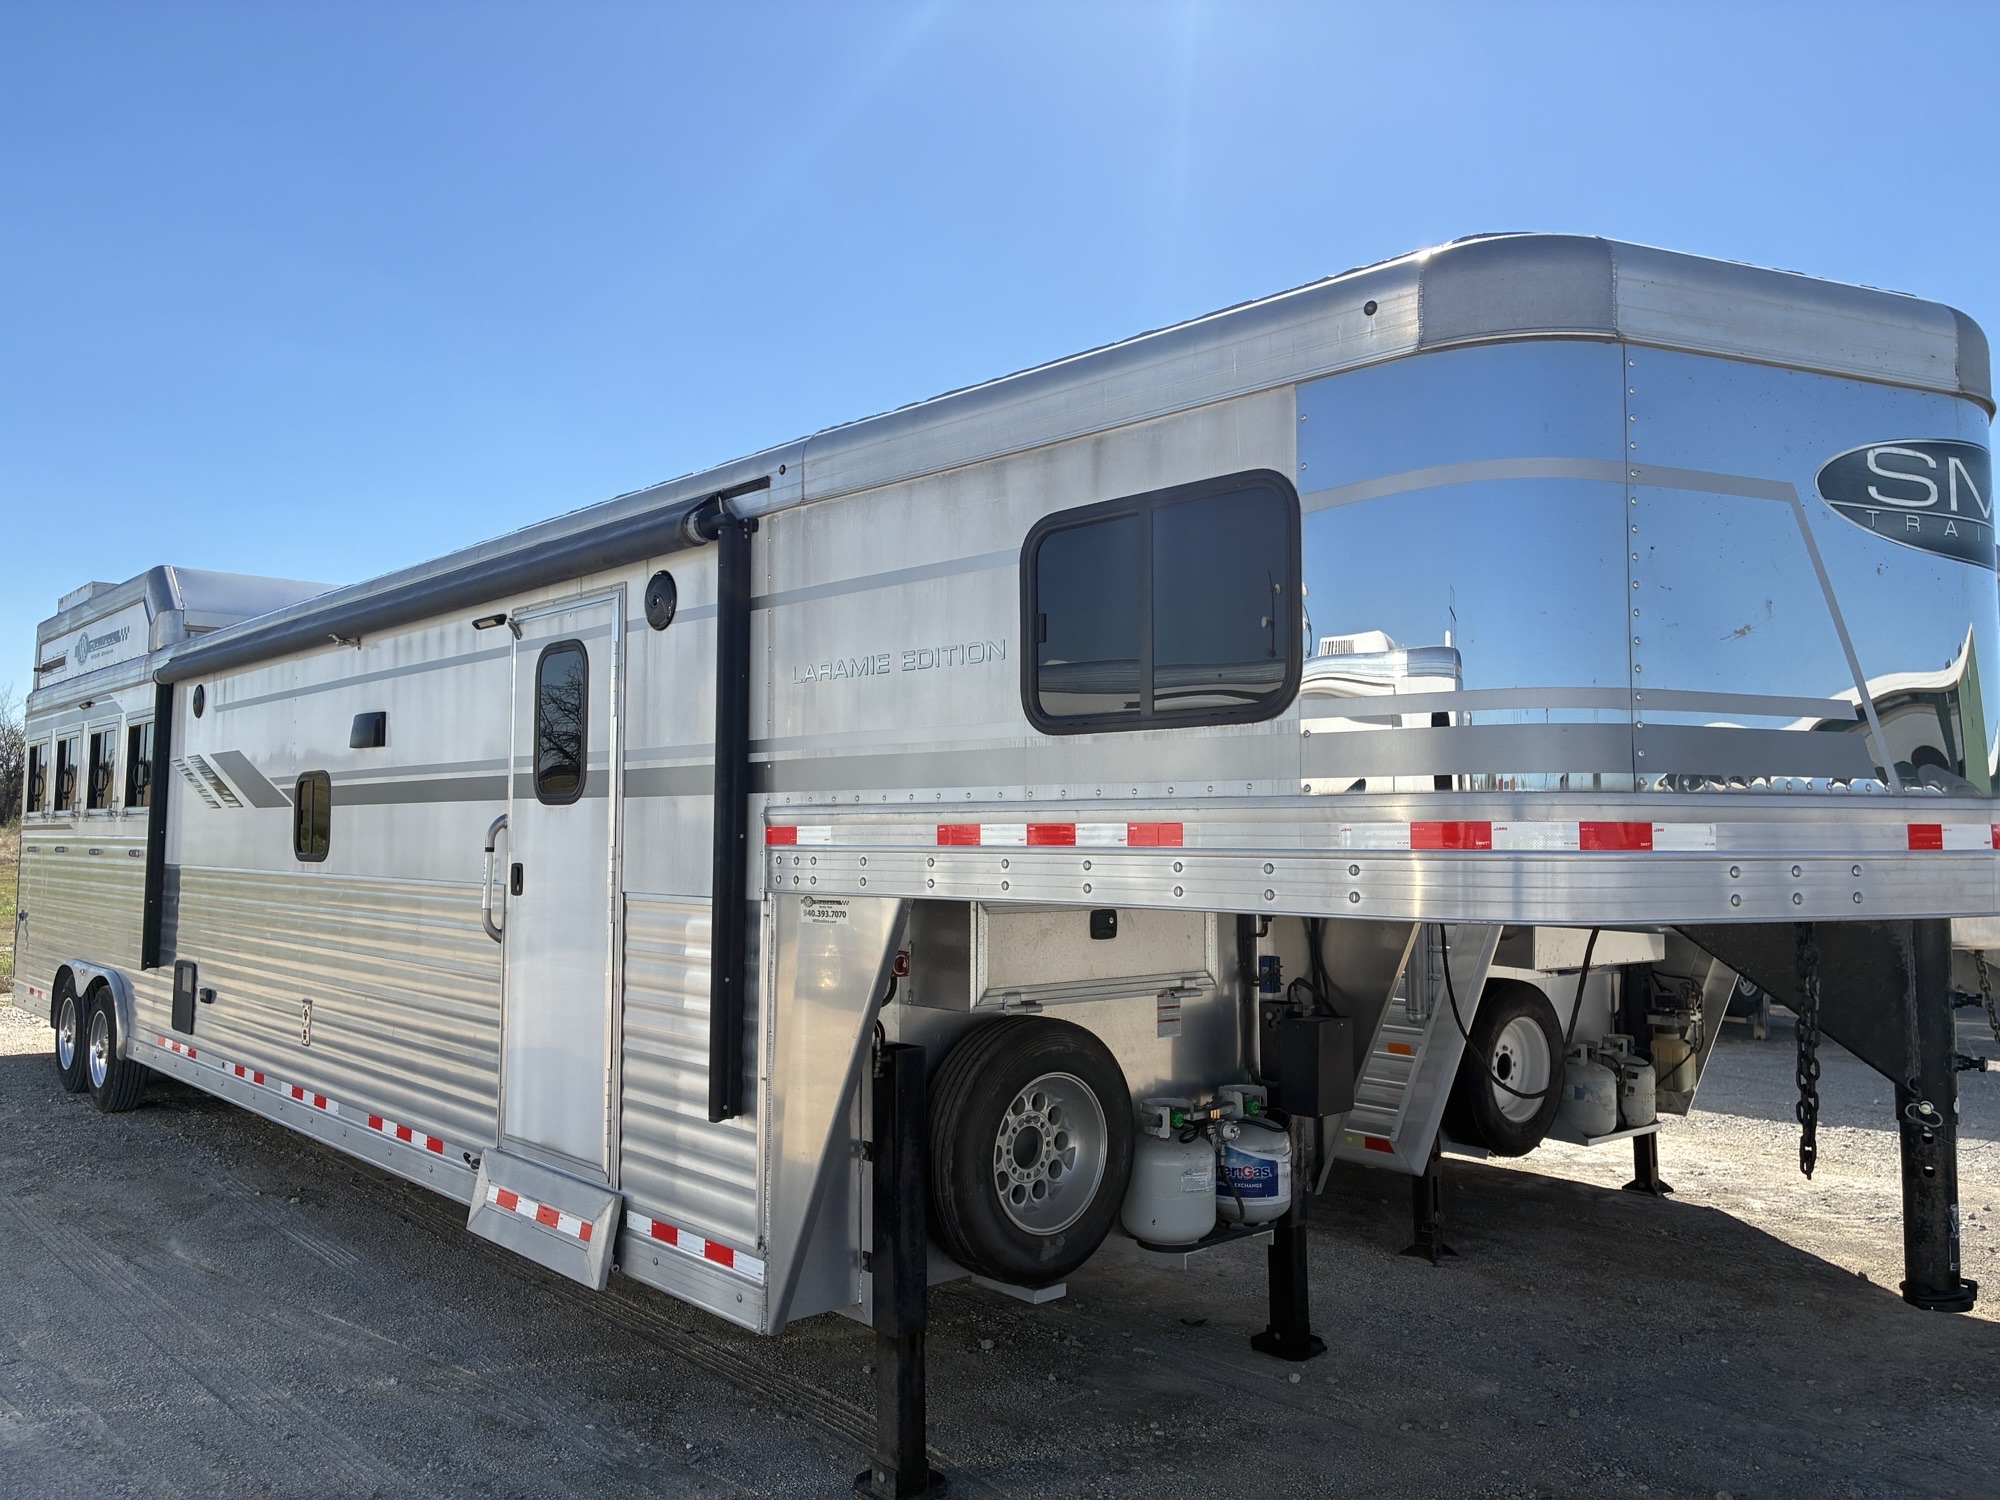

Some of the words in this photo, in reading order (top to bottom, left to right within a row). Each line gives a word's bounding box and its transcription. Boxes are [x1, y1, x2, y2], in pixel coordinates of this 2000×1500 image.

[1866, 510, 1995, 546] TRAI
[792, 653, 890, 684] LARAMIE
[901, 638, 1006, 672] EDITION
[803, 909, 847, 918] 940.393.7070
[1218, 1165, 1271, 1178] eriGas
